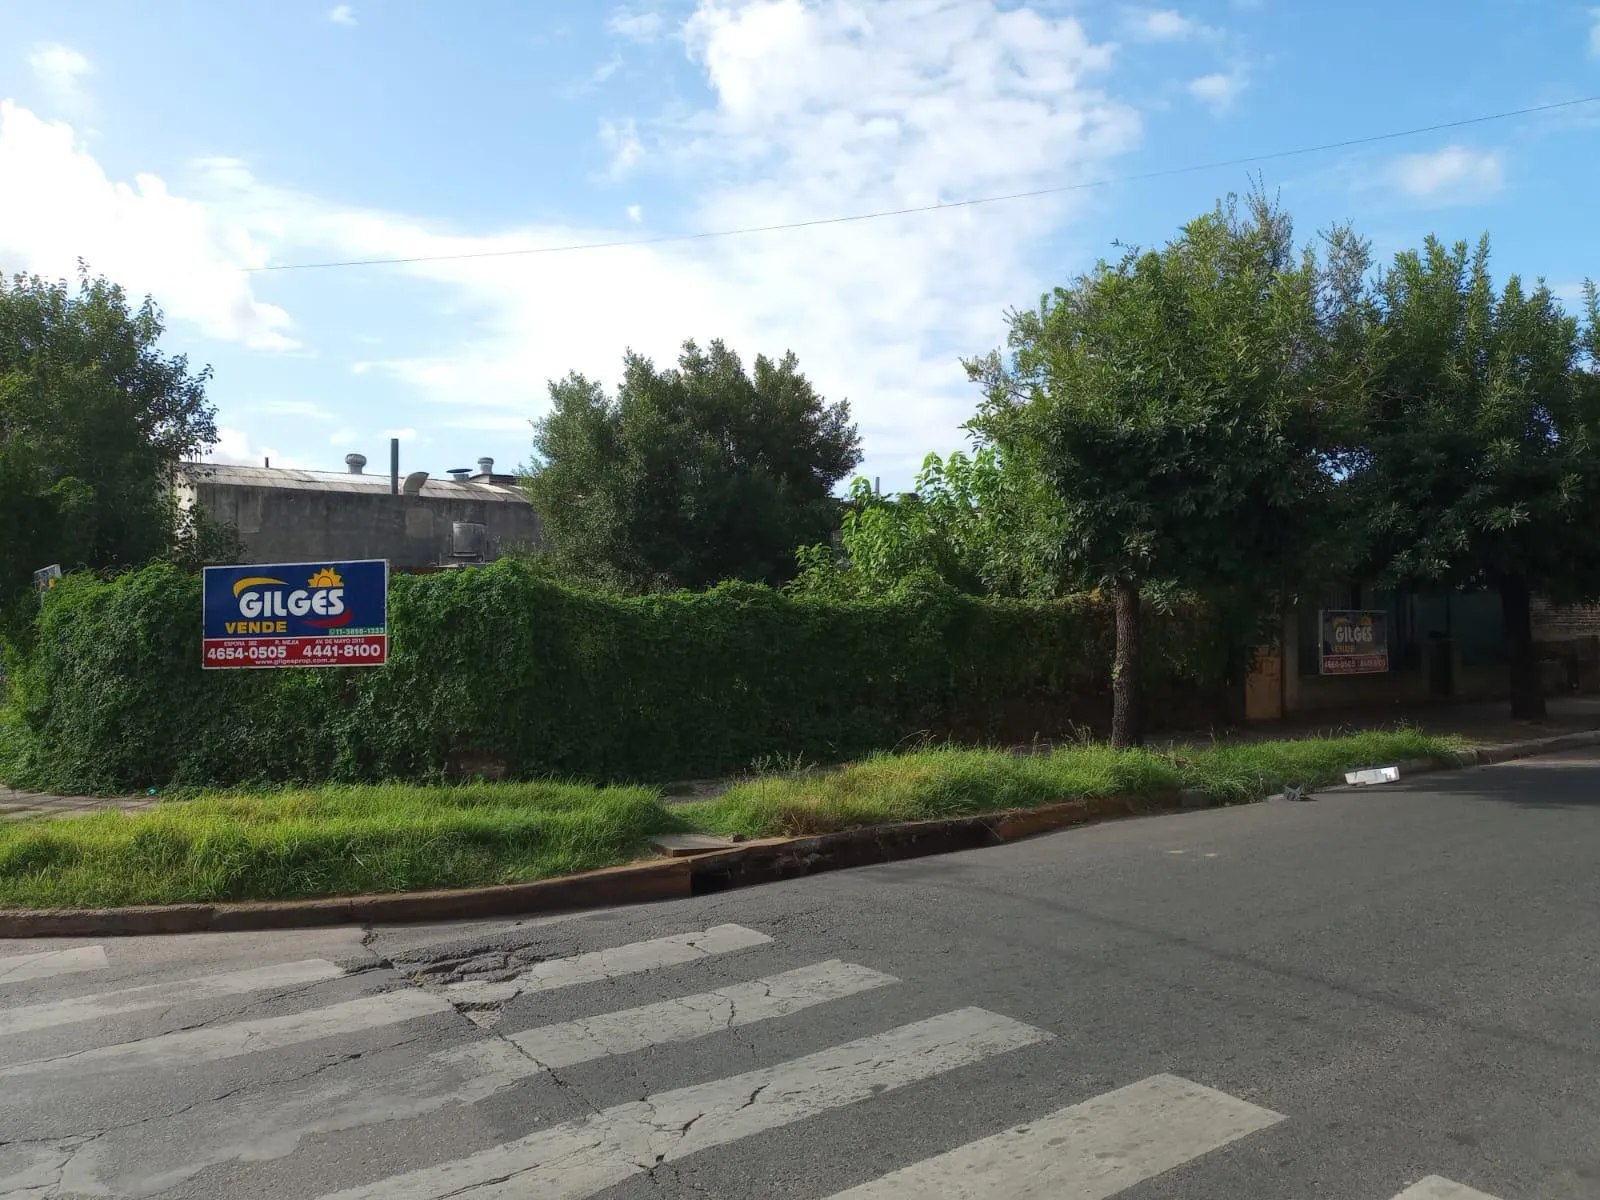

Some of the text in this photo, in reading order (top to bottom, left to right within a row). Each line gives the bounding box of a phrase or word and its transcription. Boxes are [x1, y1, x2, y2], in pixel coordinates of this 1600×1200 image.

[239, 589, 345, 618] GILGES
[225, 621, 288, 634] VENDE
[1335, 626, 1373, 642] GILGES
[207, 646, 287, 660] 4654-0505
[302, 644, 381, 657] 4441-8100
[255, 657, 337, 666] www.gilgesprop.com.ar
